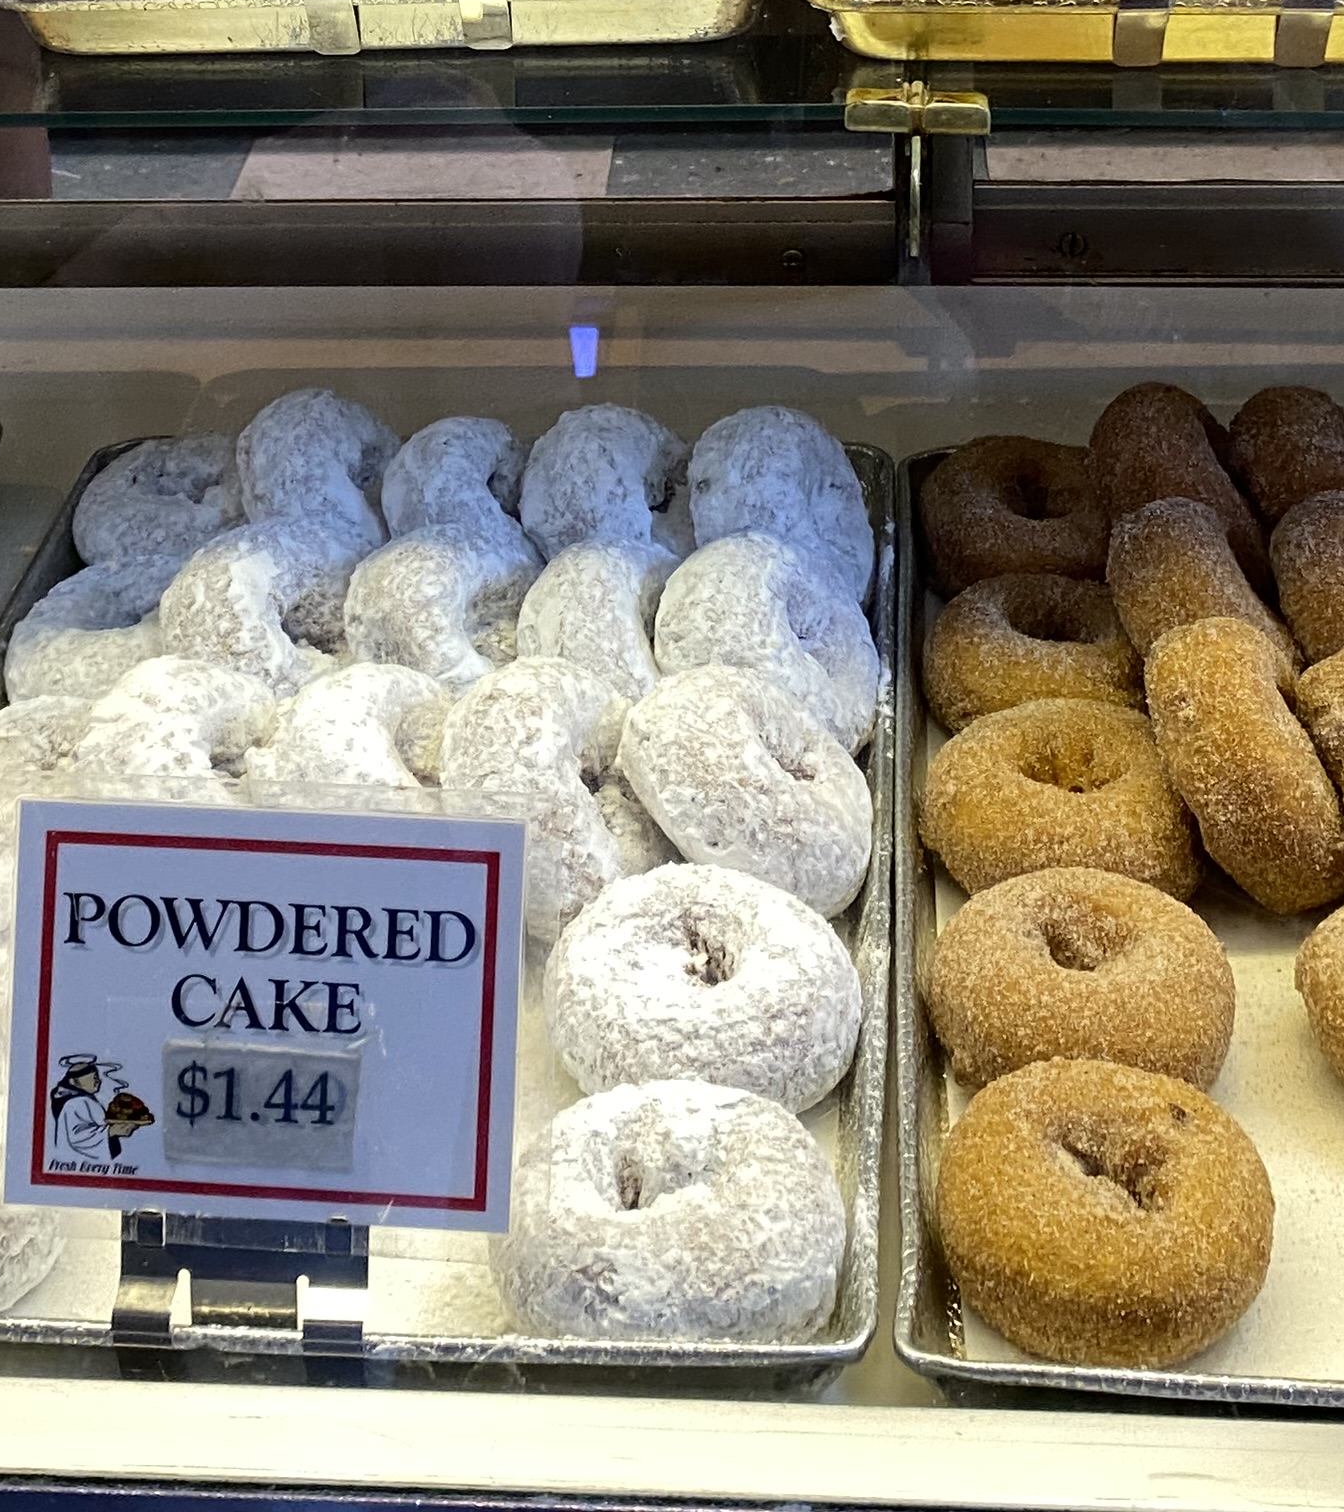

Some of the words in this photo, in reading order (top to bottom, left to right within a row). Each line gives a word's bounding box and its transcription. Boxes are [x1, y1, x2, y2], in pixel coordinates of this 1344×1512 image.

[63, 891, 476, 963] POWDERED
[171, 974, 362, 1034] CAKE
[175, 1060, 336, 1127] $1.44
